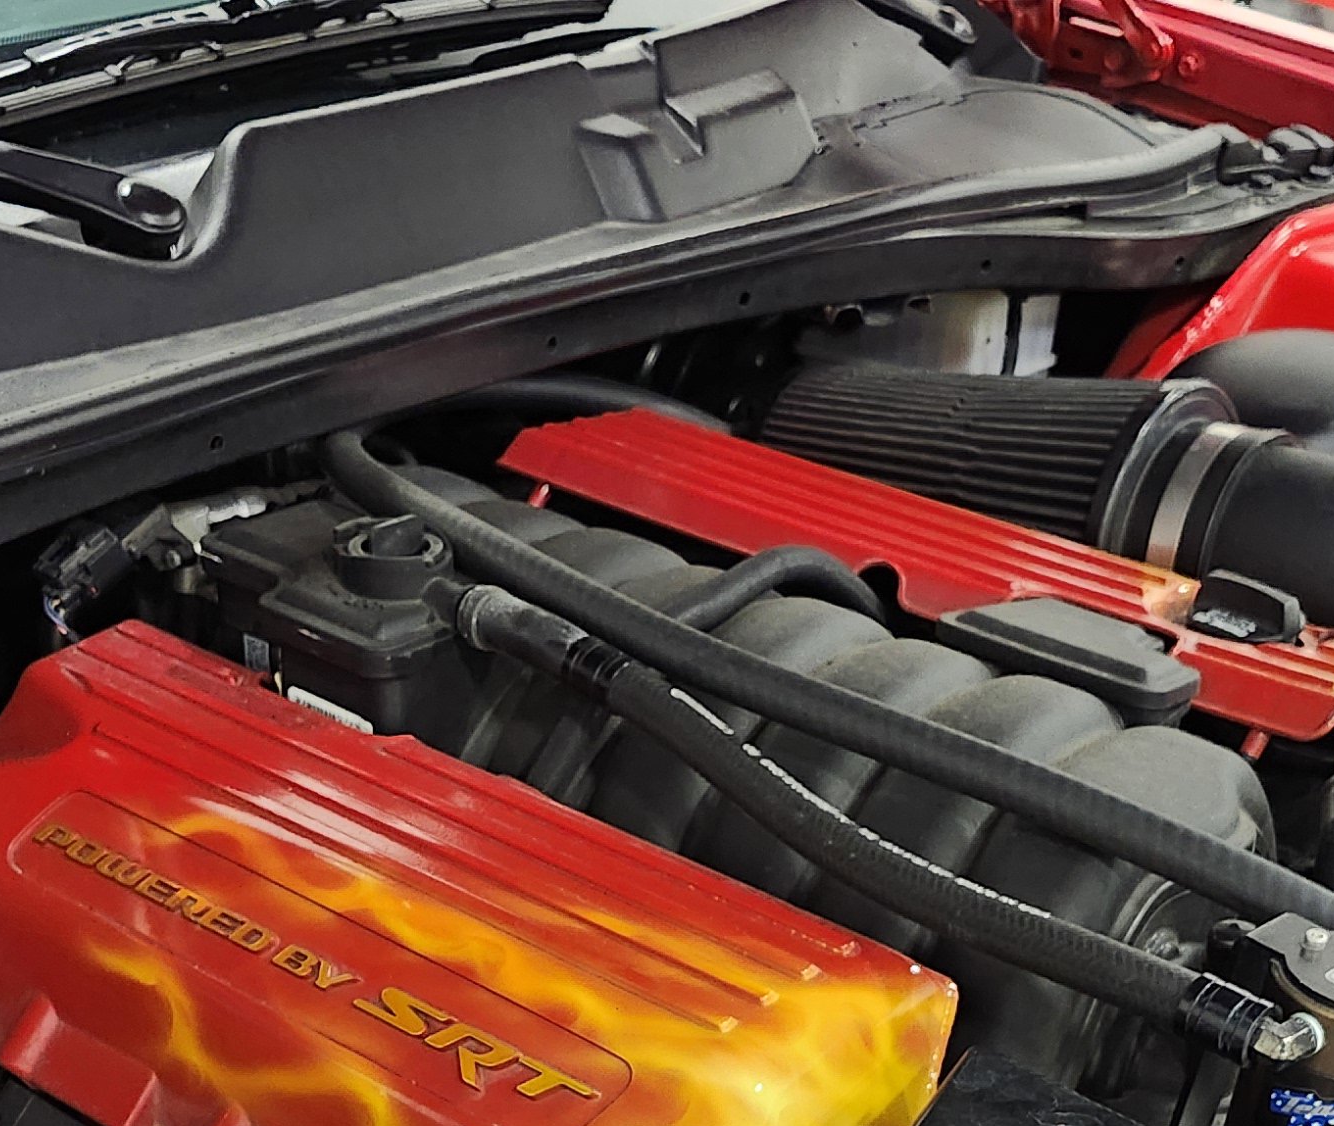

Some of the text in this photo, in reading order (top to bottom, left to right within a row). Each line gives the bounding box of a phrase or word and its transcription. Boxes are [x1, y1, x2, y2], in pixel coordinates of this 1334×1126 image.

[33, 824, 599, 1098] POWERED BY SRT
